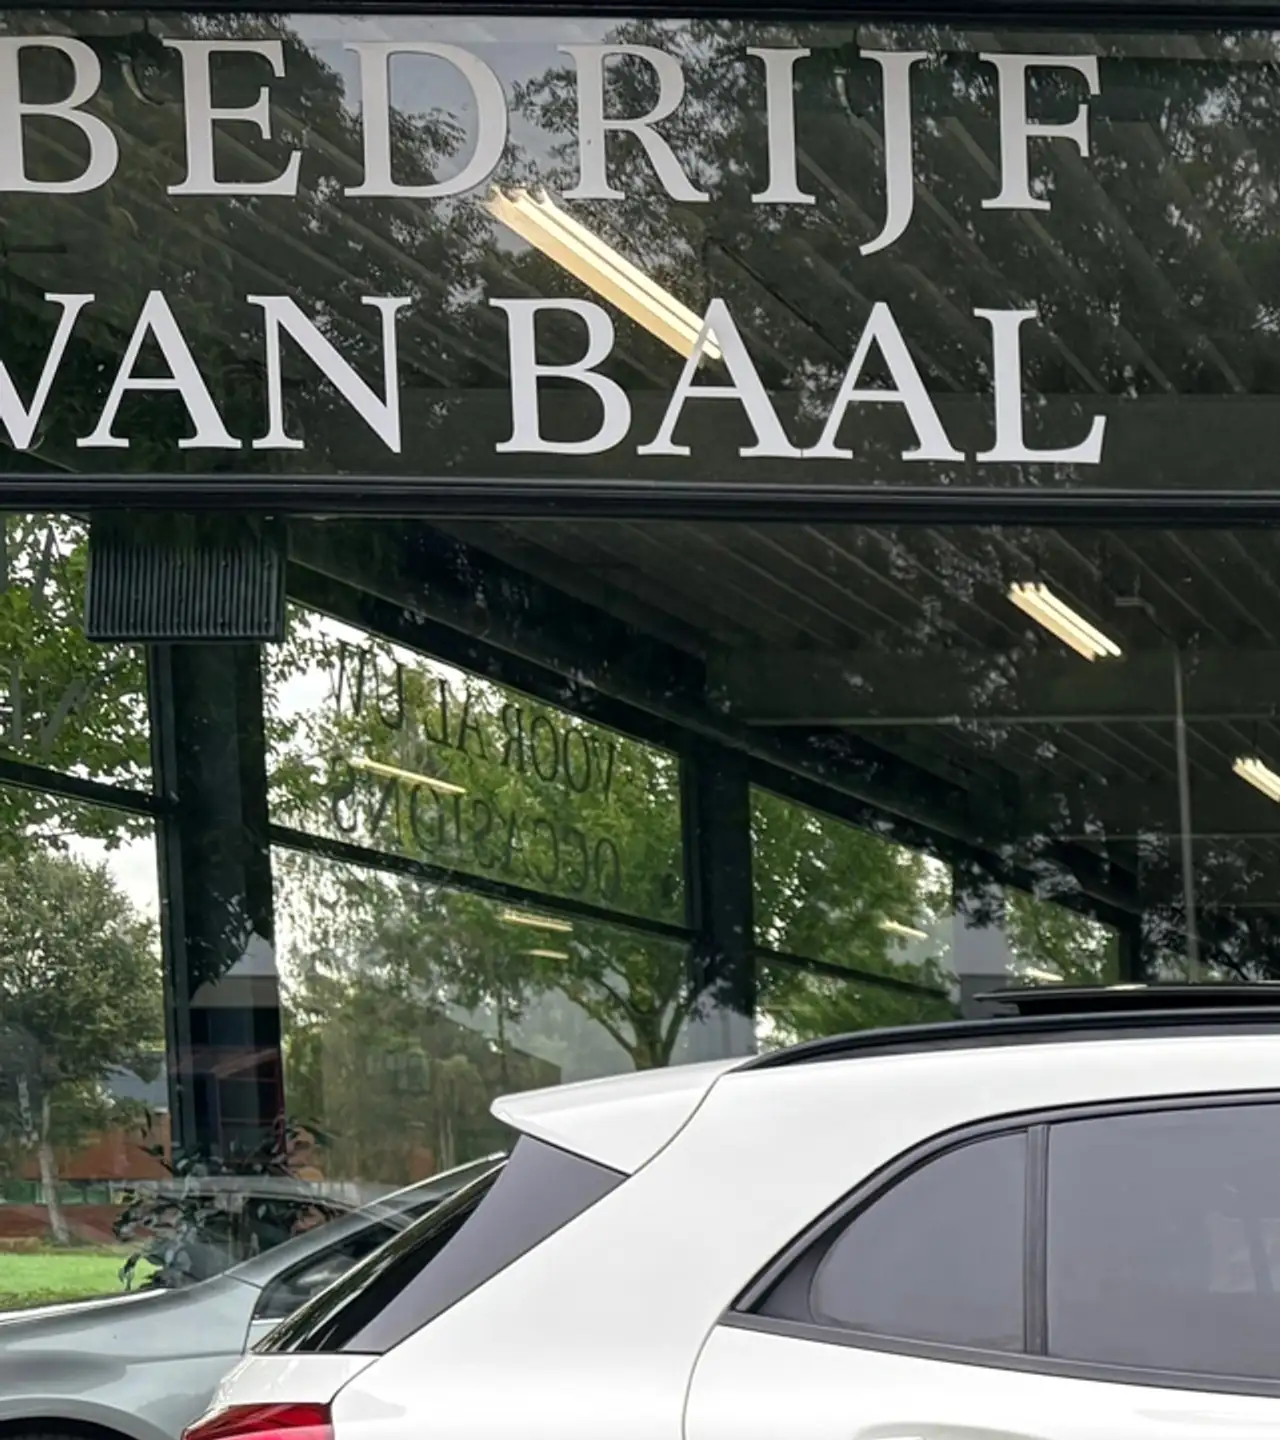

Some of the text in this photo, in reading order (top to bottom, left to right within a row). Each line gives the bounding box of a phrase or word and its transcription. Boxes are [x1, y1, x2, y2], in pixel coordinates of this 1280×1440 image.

[0, 36, 1102, 254] BEDRIJF
[0, 290, 1107, 465] VAN BAAL
